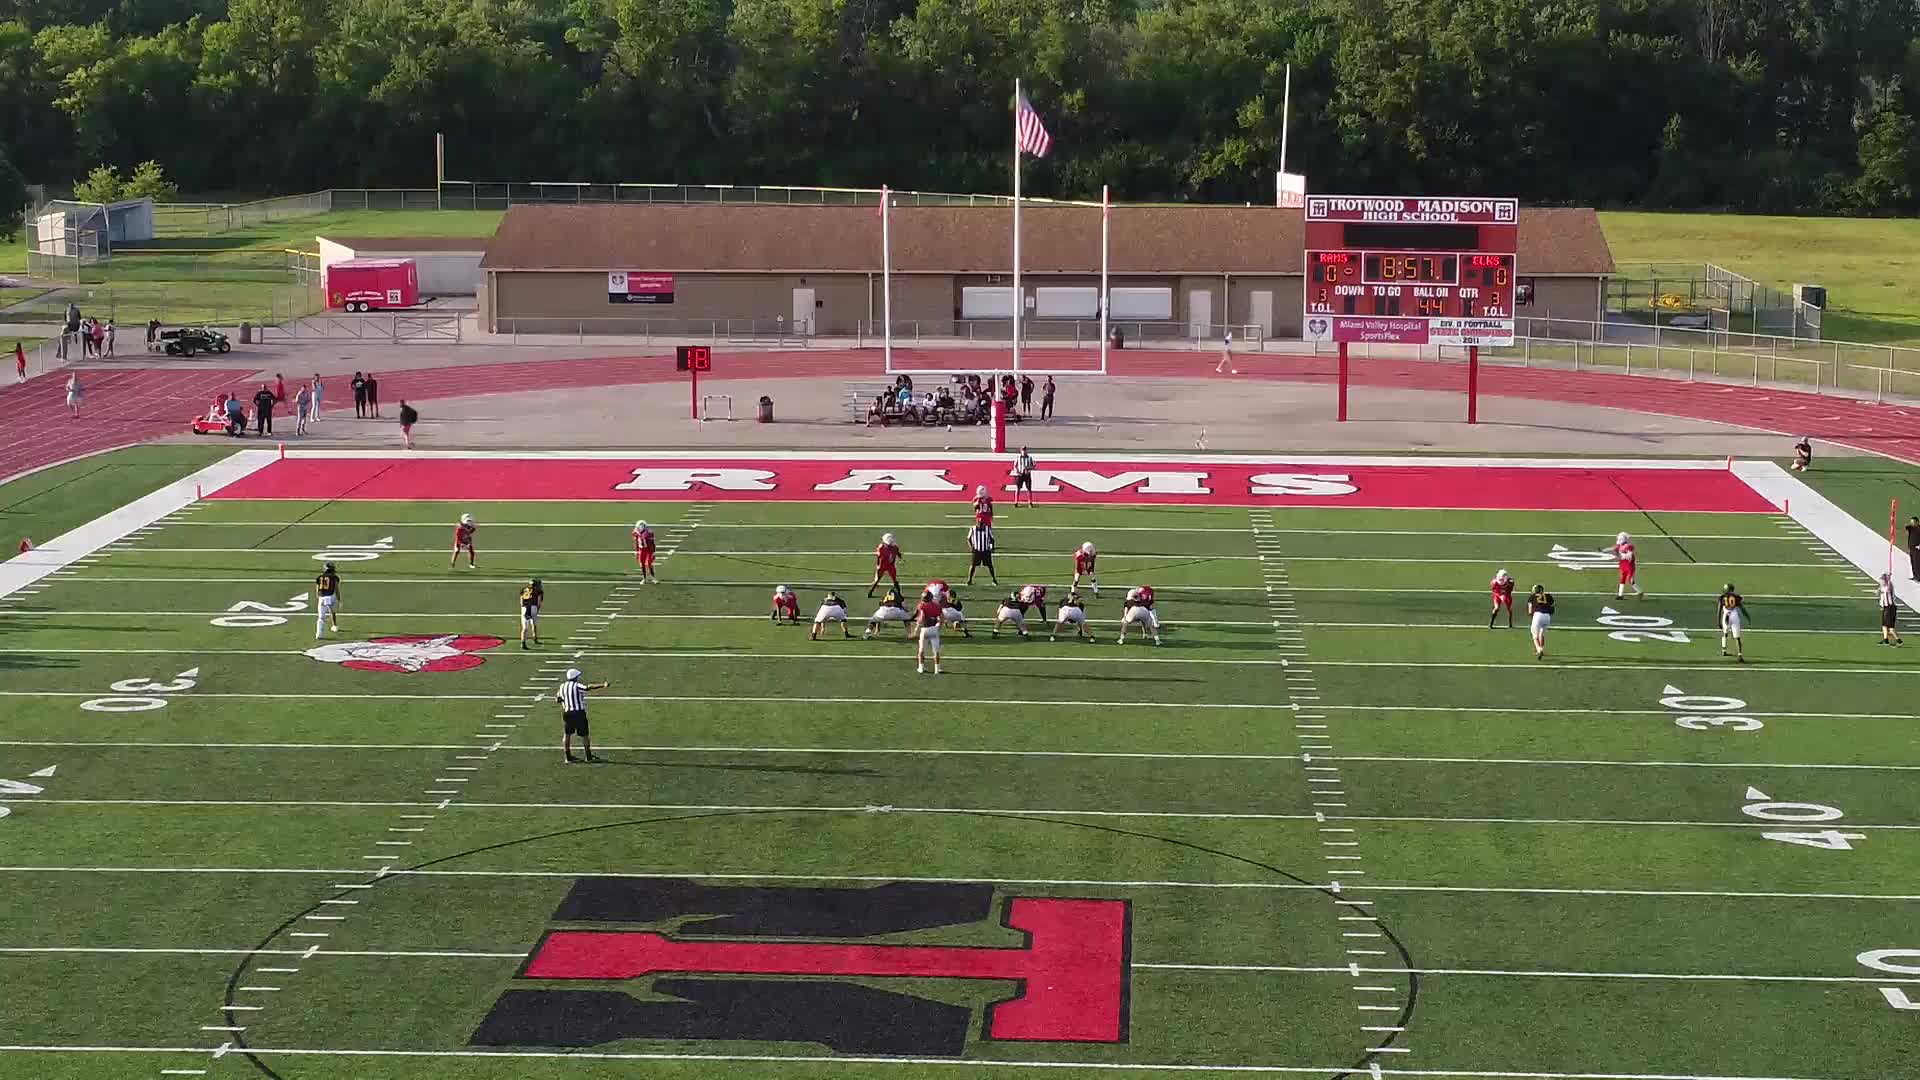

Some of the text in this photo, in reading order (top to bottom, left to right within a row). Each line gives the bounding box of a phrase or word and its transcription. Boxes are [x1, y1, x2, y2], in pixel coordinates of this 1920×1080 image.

[1329, 199, 1494, 213] TROTWOOD MADISON
[1363, 211, 1458, 222] HIGH SCHOOL
[1320, 253, 1348, 263] RAMS
[1472, 255, 1500, 266] ELKS
[1334, 285, 1479, 299] DOWN TO GO BALL ON QTR
[614, 467, 1359, 496] RAMS
[209, 599, 309, 628] 20
[1596, 615, 1691, 643] 20
[79, 675, 199, 712] 30
[1658, 695, 1765, 731] 30
[1741, 802, 1867, 850] 40
